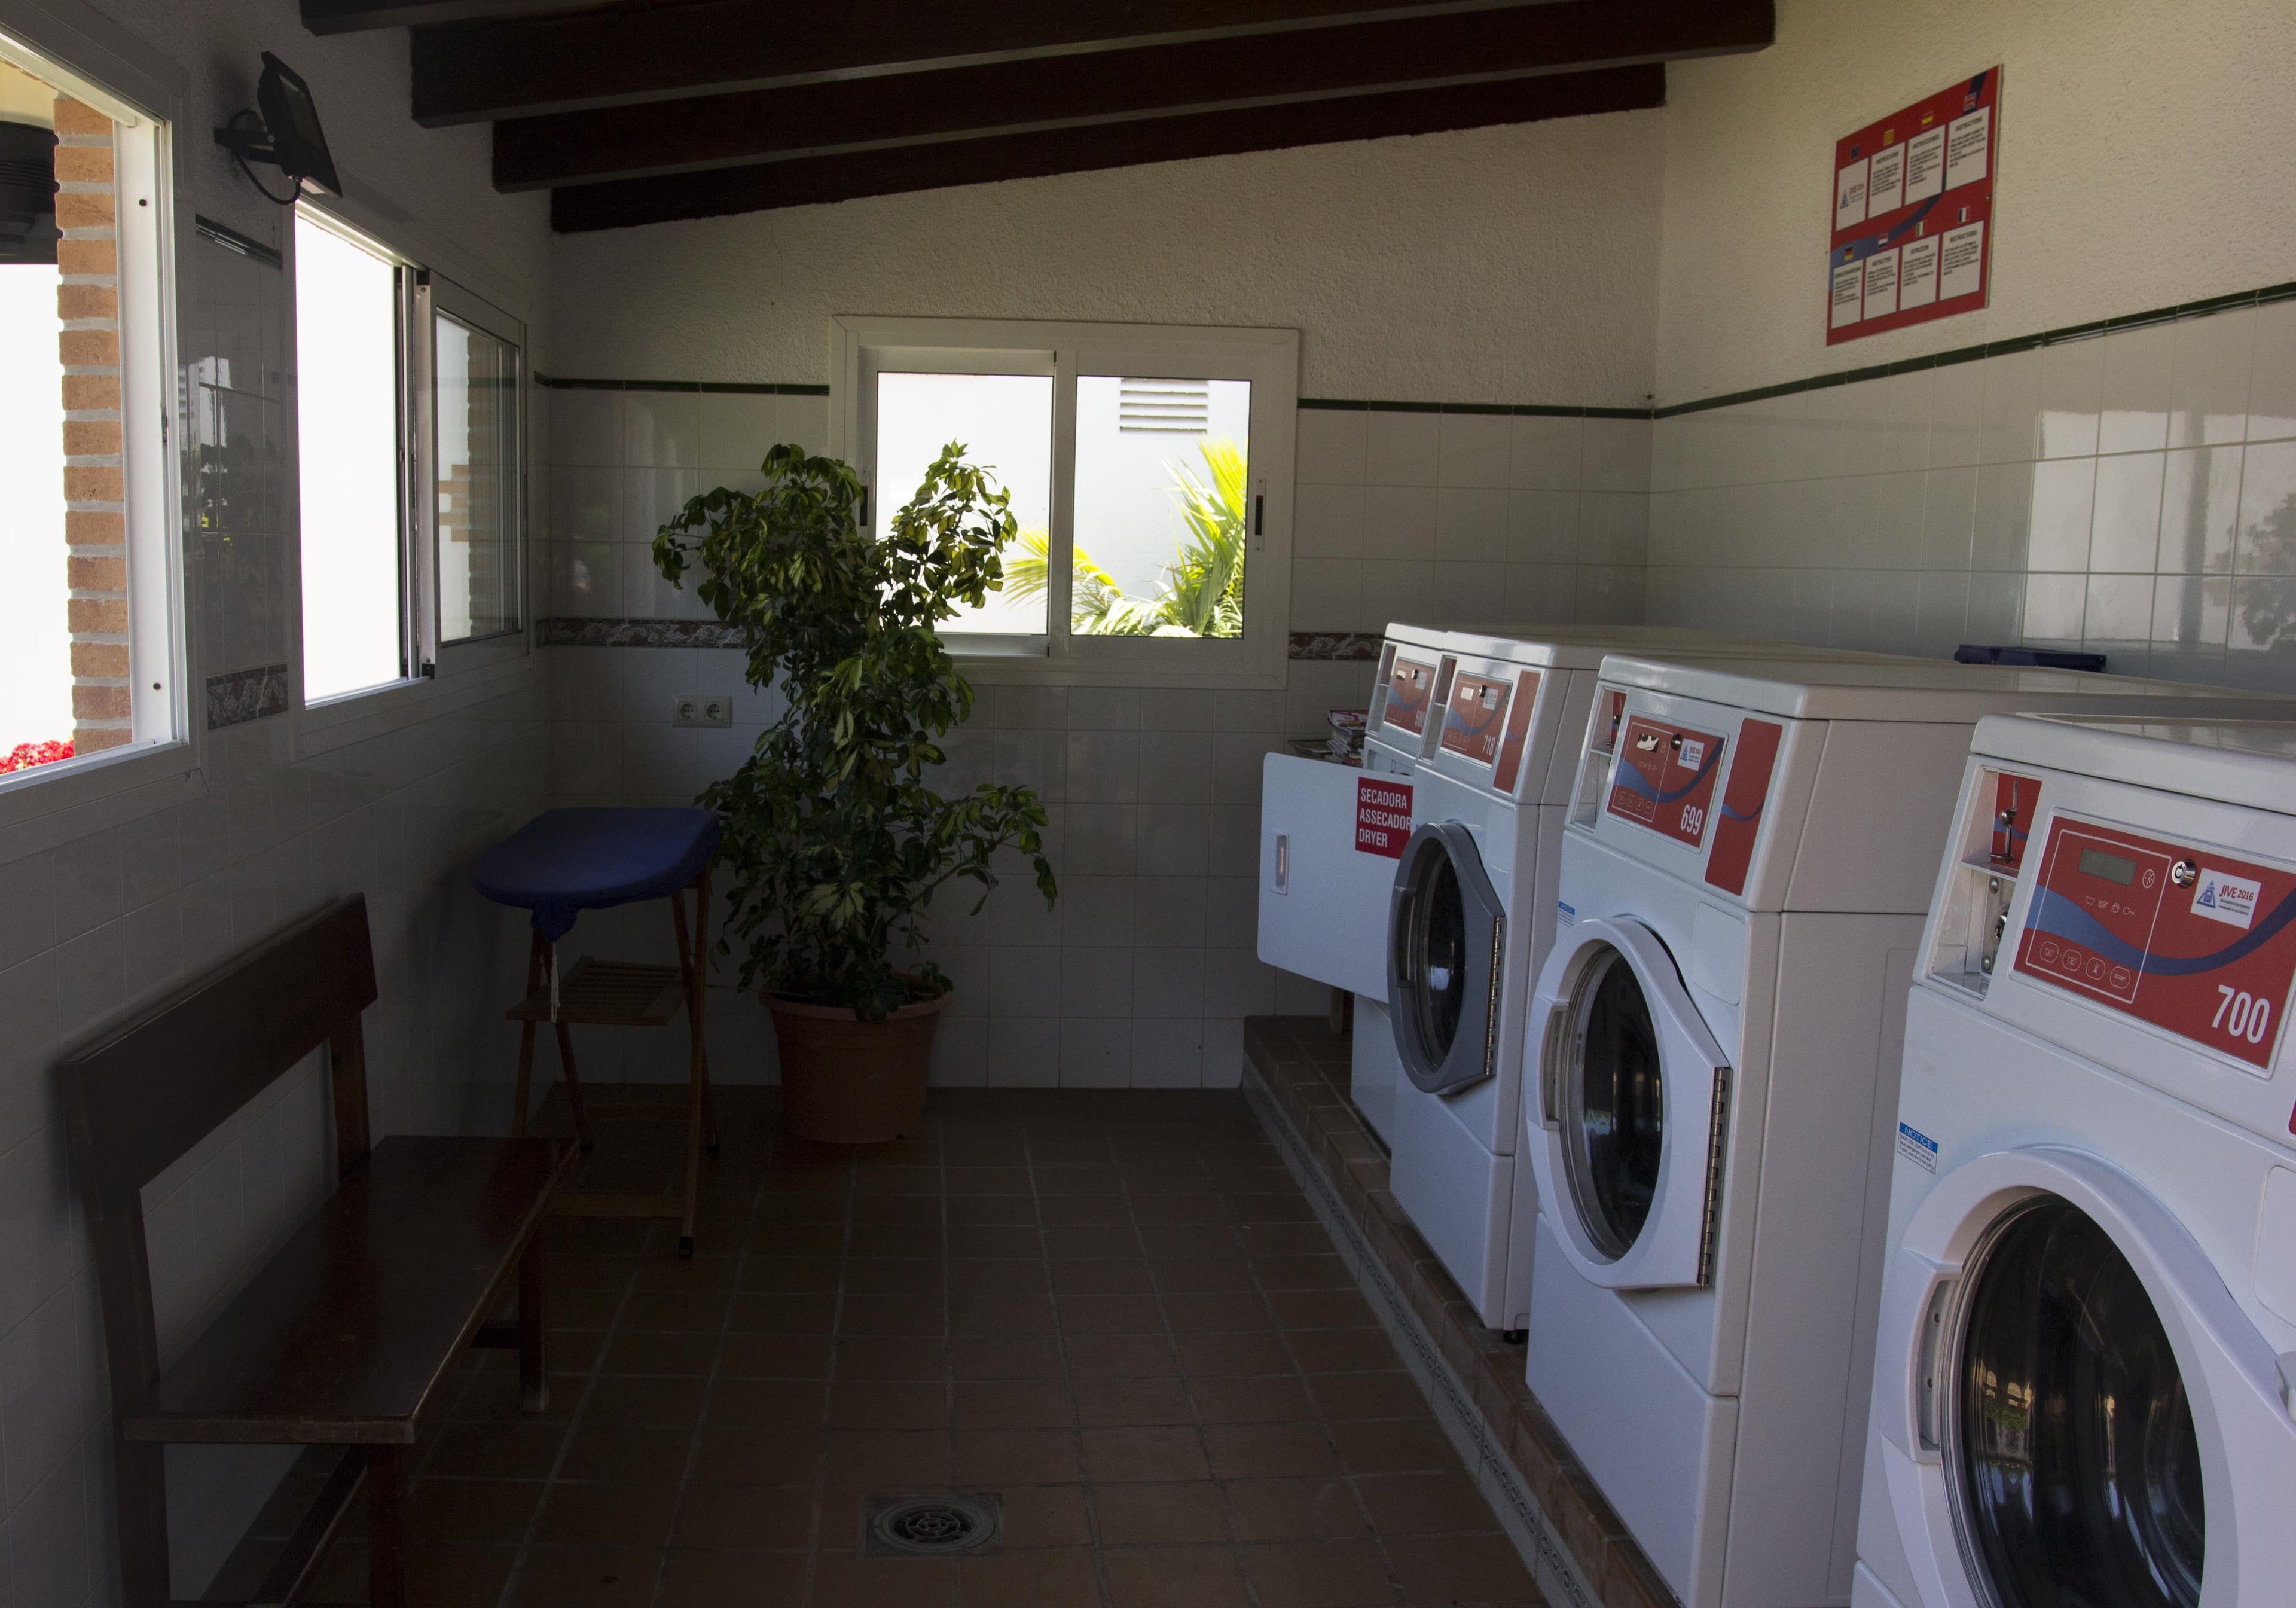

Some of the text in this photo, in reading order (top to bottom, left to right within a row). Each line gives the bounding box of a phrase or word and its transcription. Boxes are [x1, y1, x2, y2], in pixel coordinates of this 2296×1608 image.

[1482, 734, 1495, 756] 718
[1361, 788, 1407, 809] SECADORA
[1360, 808, 1412, 831] ASSECADOR
[1680, 804, 1703, 835] 699
[1359, 828, 1388, 847] DRYER
[2219, 884, 2254, 901] JIVE 2016
[2212, 984, 2270, 1043] 700
[1904, 1126, 1933, 1149] NOTICE
